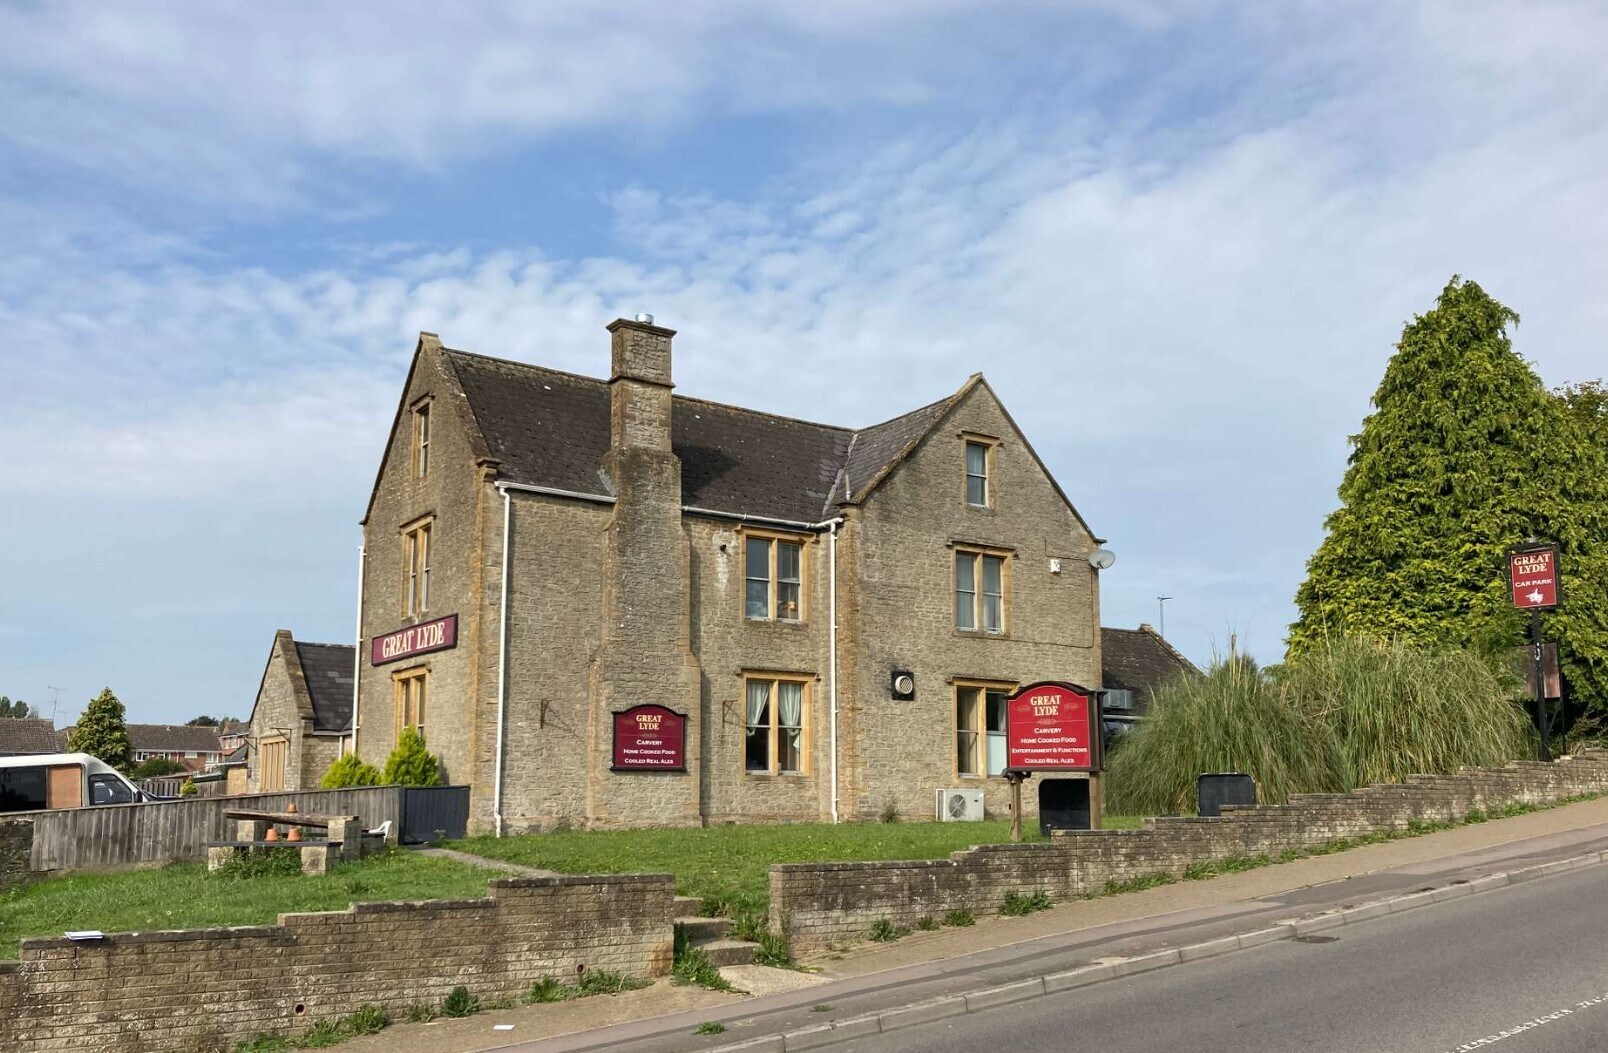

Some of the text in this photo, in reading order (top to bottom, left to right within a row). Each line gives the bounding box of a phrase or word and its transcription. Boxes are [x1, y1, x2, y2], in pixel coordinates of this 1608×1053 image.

[1514, 553, 1550, 566] GREAT
[1519, 563, 1548, 574] LYDE
[382, 622, 445, 658] GREAT LYDE
[1030, 695, 1062, 706] GREAT
[1034, 706, 1058, 716] LYDE
[636, 714, 662, 722] GREAT
